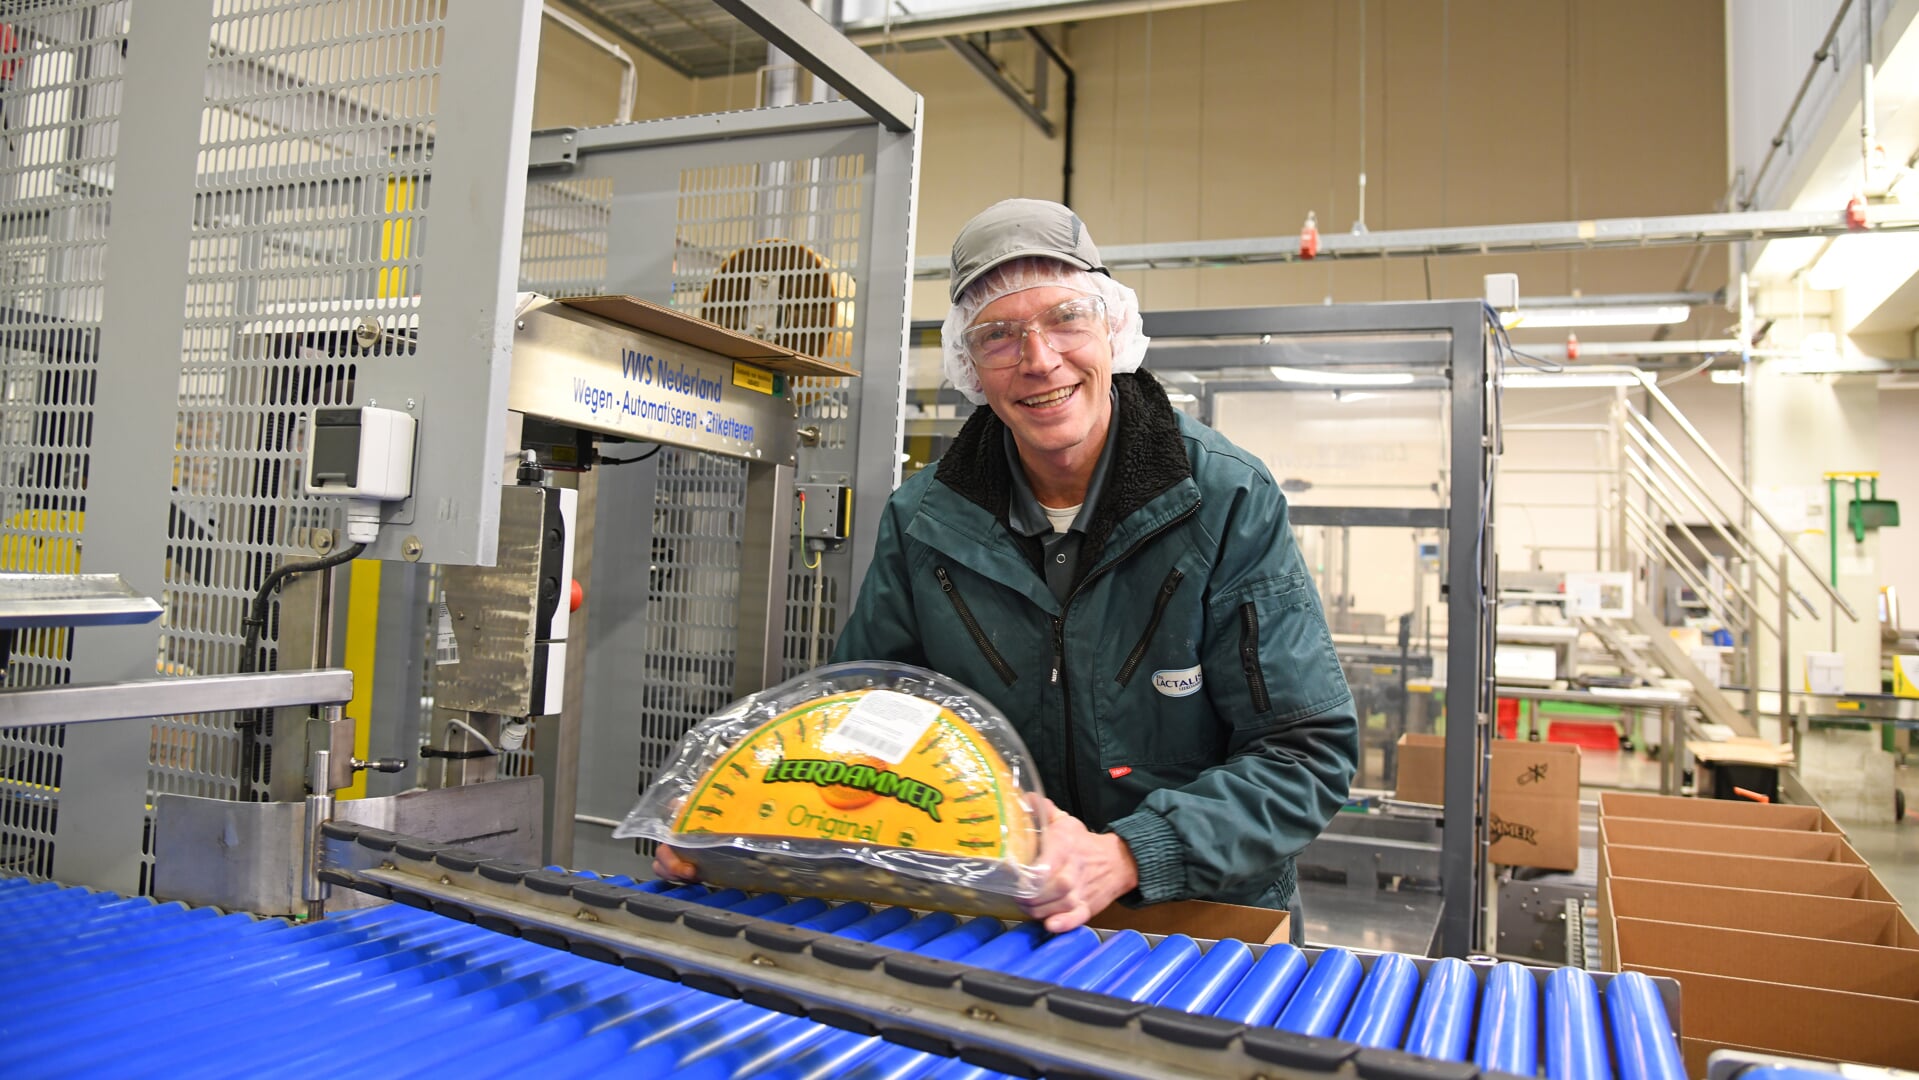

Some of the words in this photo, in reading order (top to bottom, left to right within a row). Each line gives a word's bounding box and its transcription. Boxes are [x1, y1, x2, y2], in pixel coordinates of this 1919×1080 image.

[573, 376, 613, 414] Wegen
[622, 390, 698, 430] Automatiseren
[621, 347, 654, 385] VWS
[657, 358, 723, 404] Nederland
[763, 756, 944, 823] LEERDAMMER
[787, 804, 883, 843] Original
